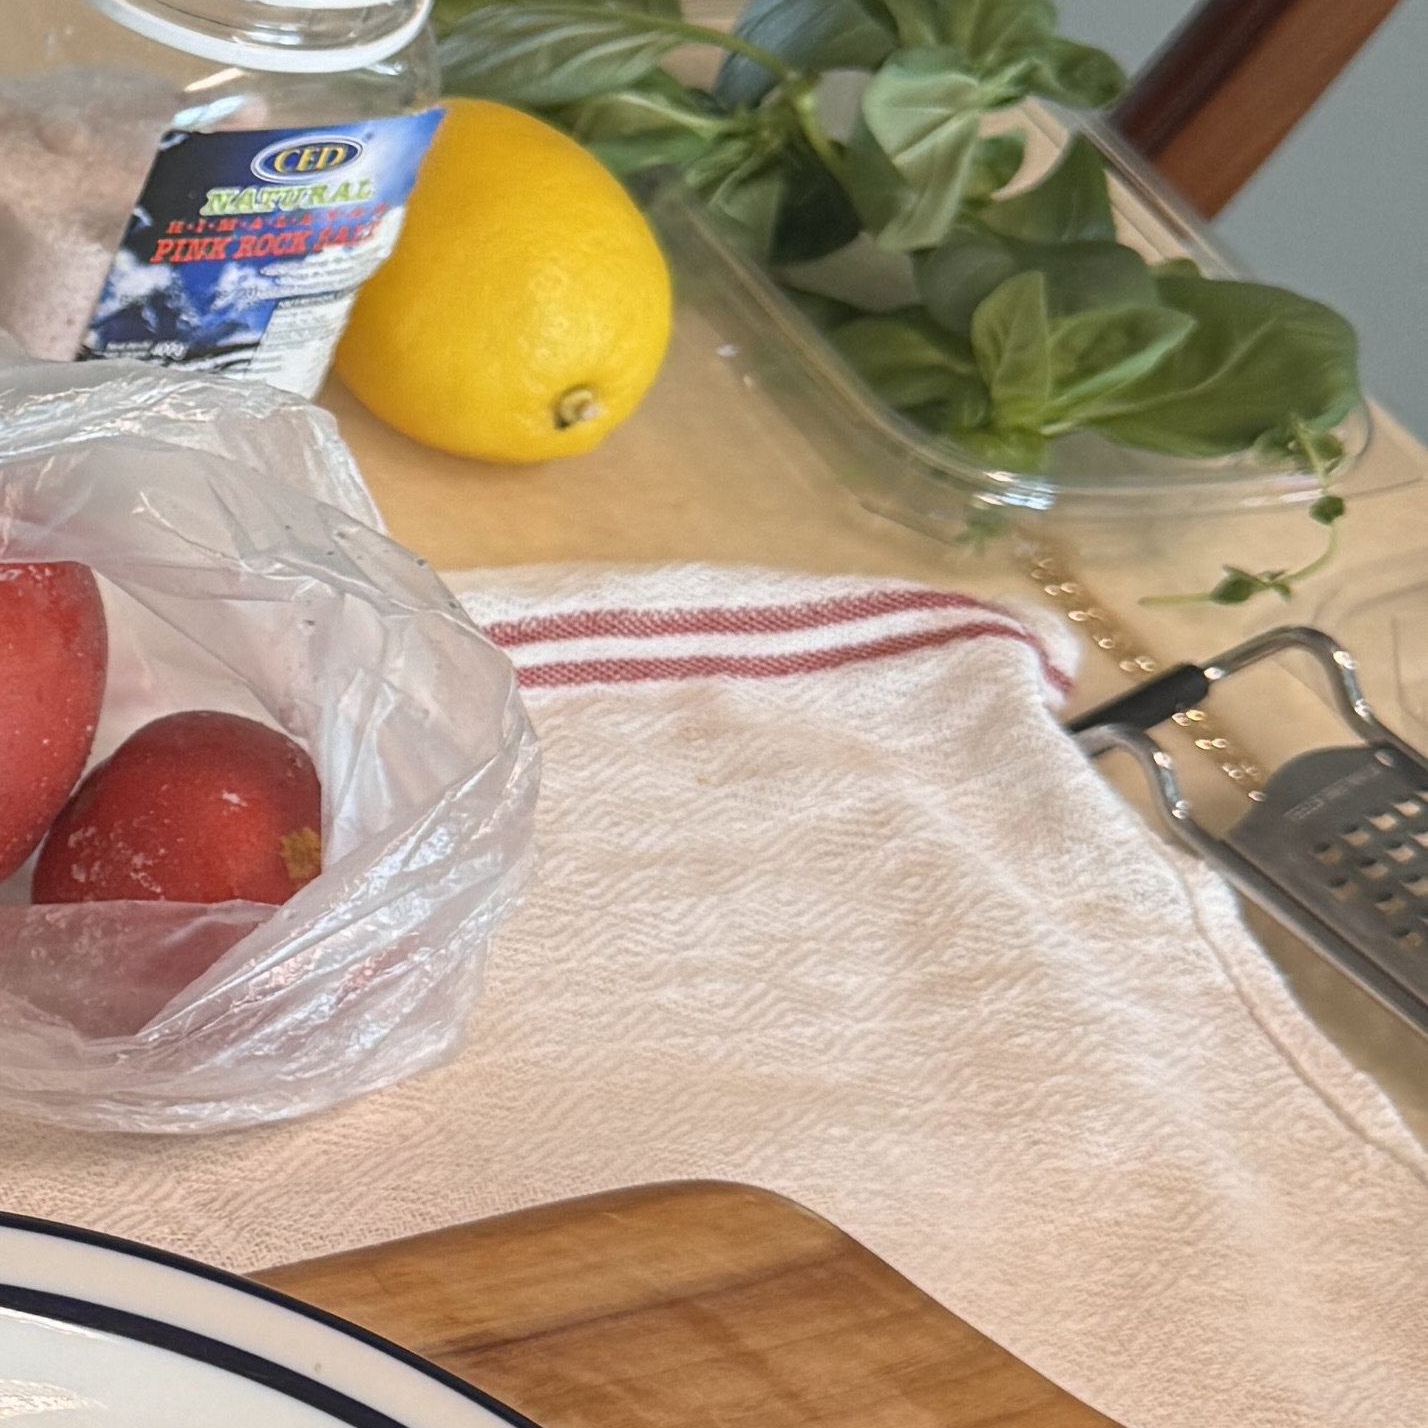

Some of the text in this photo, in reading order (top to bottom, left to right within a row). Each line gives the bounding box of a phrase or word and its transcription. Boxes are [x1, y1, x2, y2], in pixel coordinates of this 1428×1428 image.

[200, 178, 376, 217] NATURAL
[150, 236, 233, 264] PINK
[233, 229, 314, 260] ROCK
